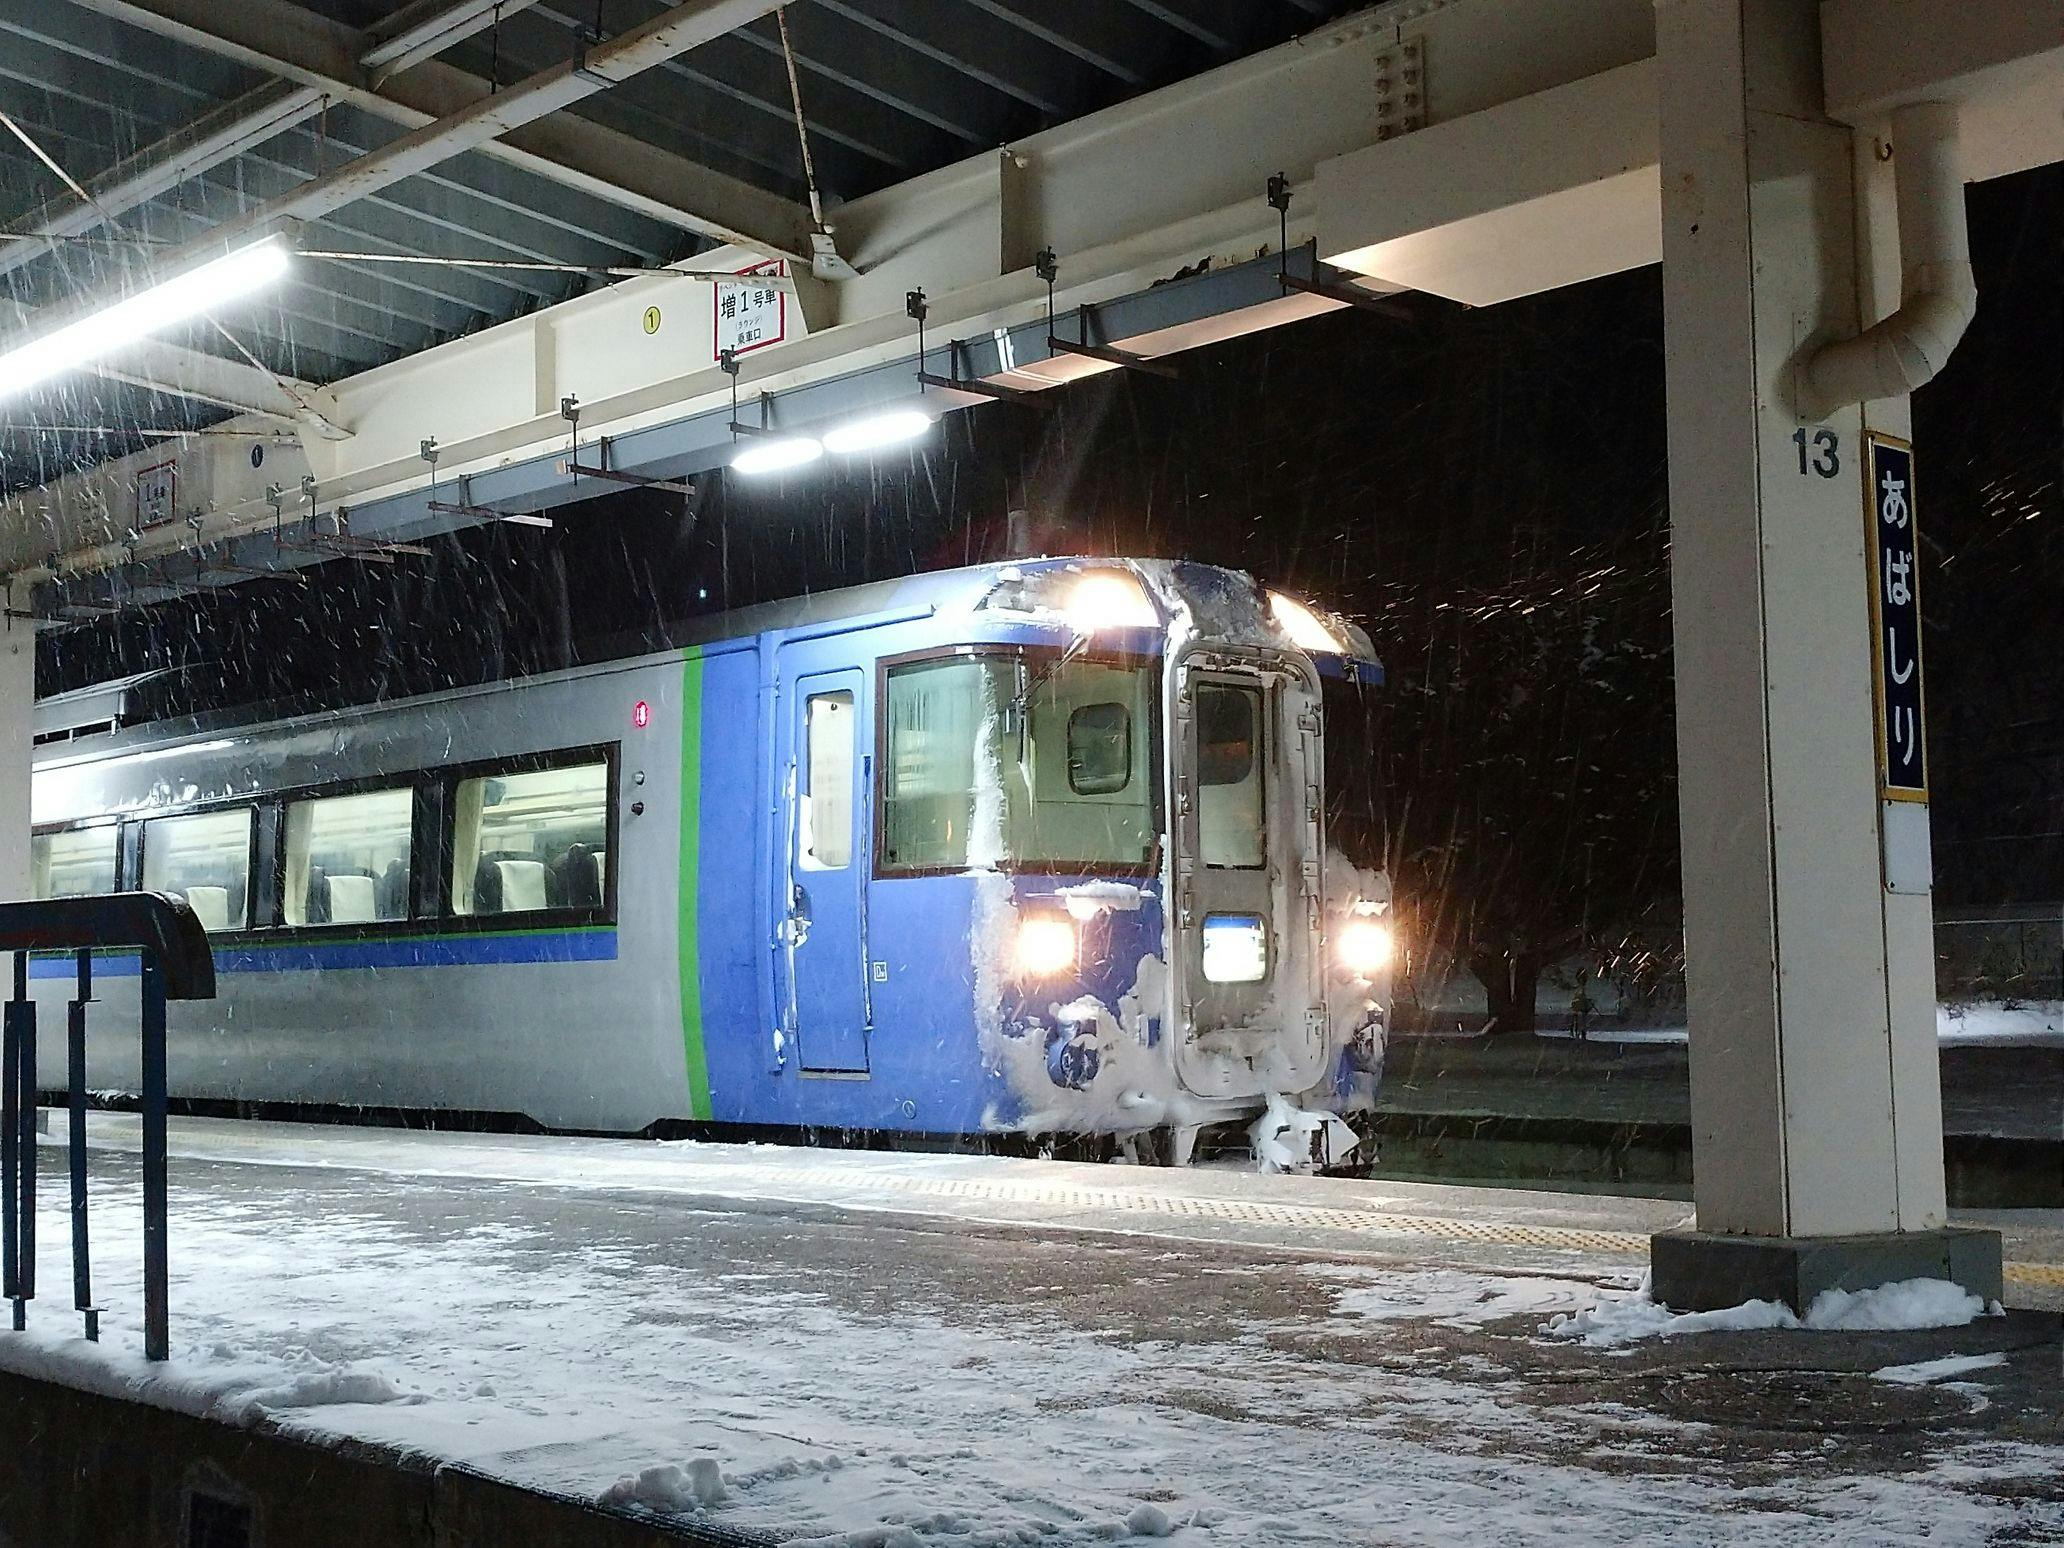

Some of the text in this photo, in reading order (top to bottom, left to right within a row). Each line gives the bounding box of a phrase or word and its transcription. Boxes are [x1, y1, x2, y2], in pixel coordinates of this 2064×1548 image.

[1792, 427, 1840, 479] 13
[1882, 470, 1914, 766] あばしり
